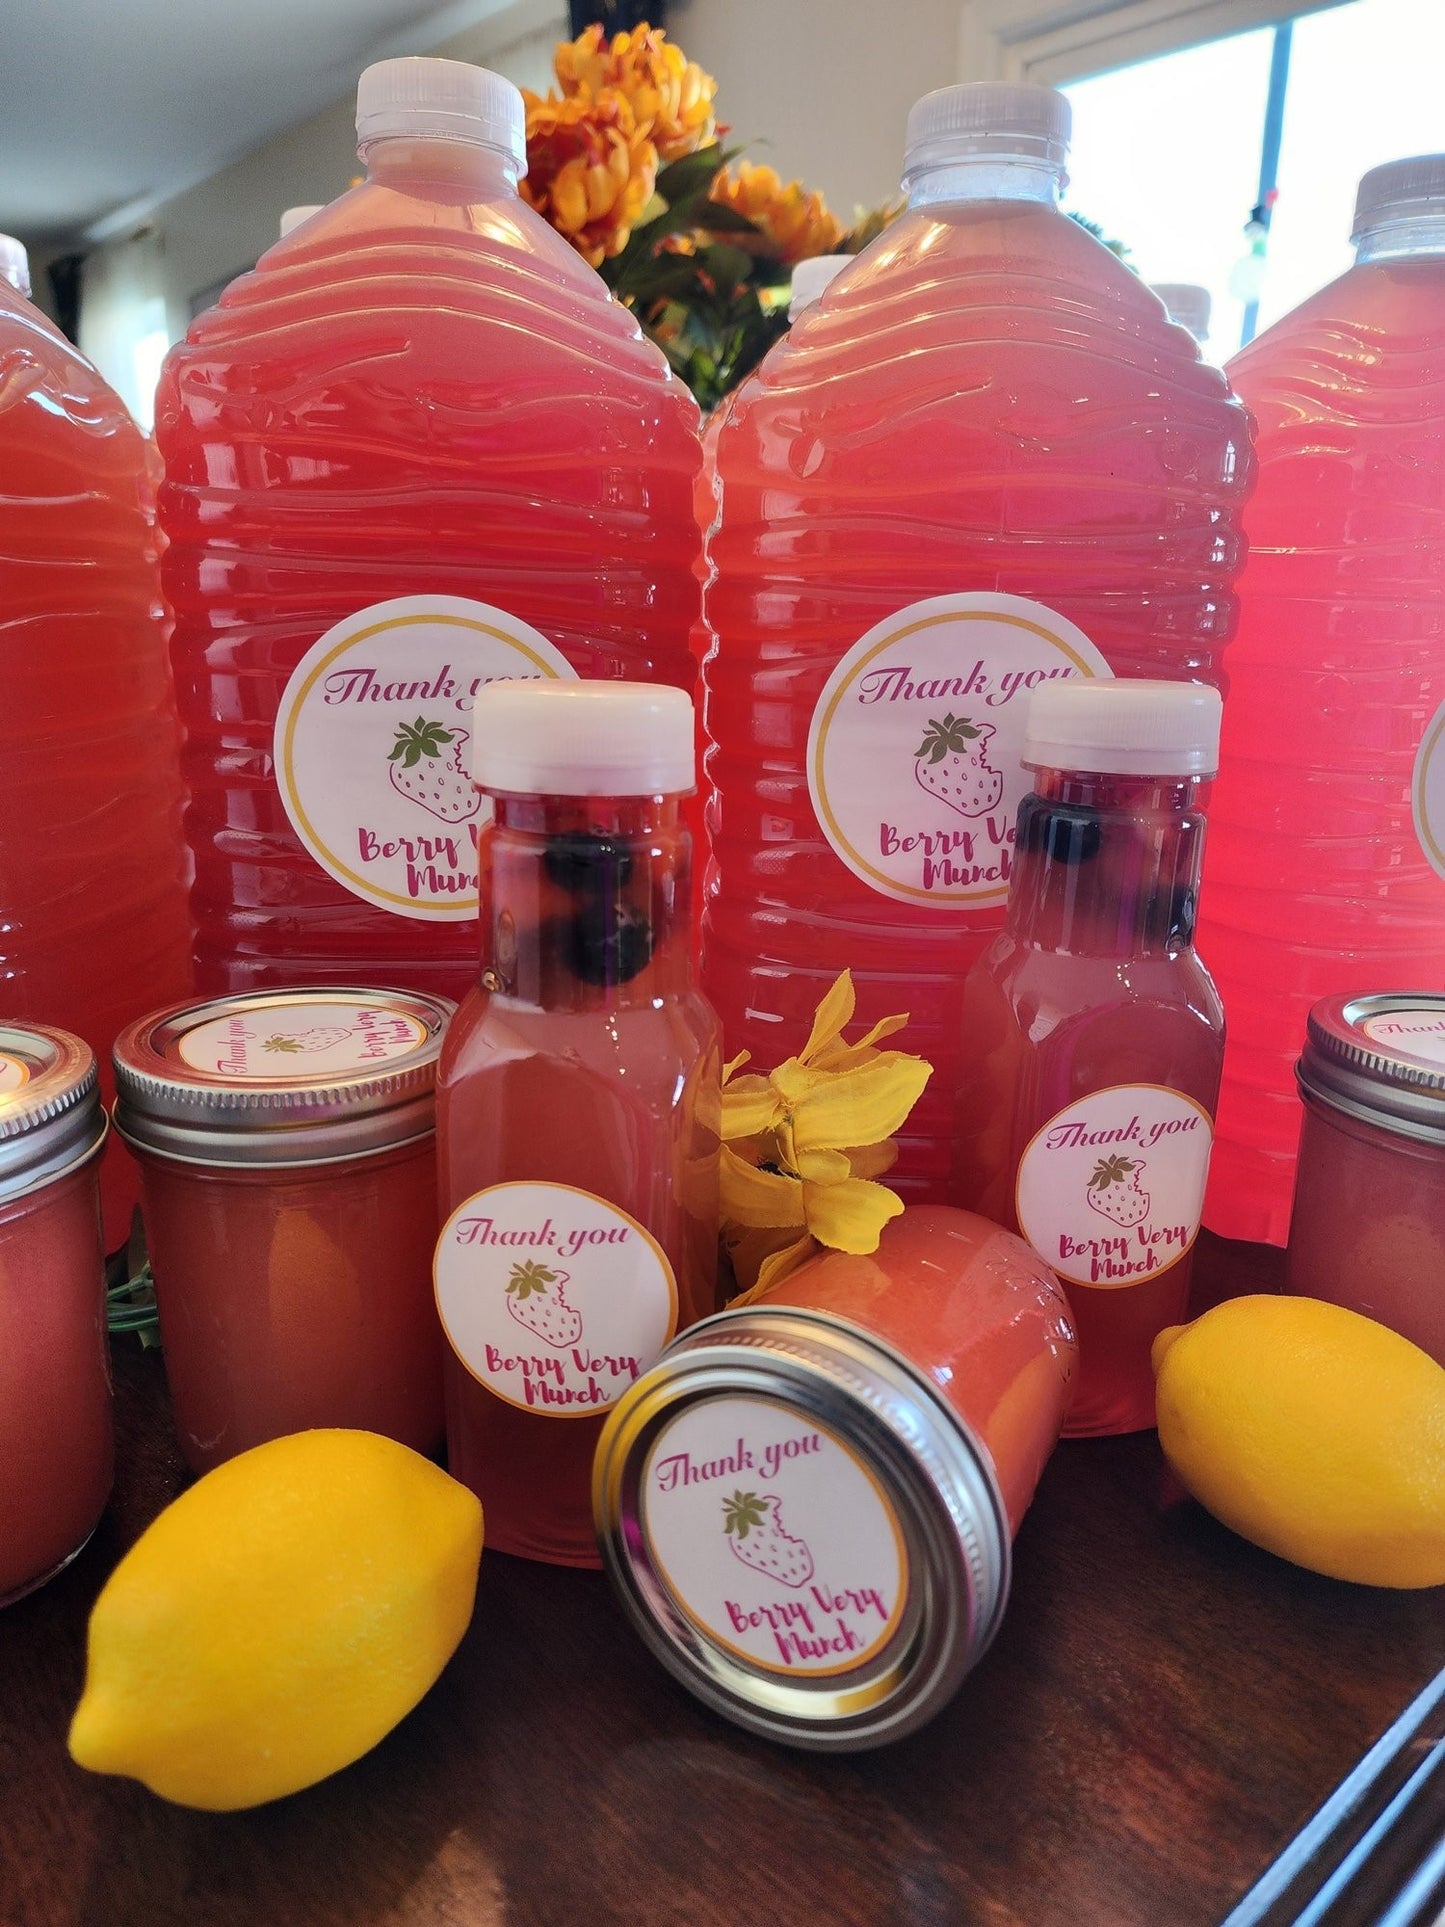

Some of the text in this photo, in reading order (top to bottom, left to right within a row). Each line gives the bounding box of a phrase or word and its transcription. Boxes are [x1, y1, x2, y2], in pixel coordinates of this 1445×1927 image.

[324, 664, 461, 705] Thank
[858, 660, 993, 704] Thank
[358, 827, 460, 869] Berry
[880, 815, 1017, 863] Berry Ve
[406, 863, 478, 897] Mun
[217, 1019, 257, 1074] Thank you
[351, 1010, 392, 1059] Berry Very
[1046, 1116, 1201, 1150] Thank you
[456, 1217, 632, 1258] Thank you
[1059, 1224, 1192, 1260] Berry Very
[1090, 1248, 1163, 1282] Munch
[485, 1344, 642, 1386] Berry Very
[523, 1376, 611, 1406] Munch
[655, 1434, 823, 1492] Thank you
[724, 1584, 889, 1634] Berry Very
[773, 1618, 865, 1665] Munch
